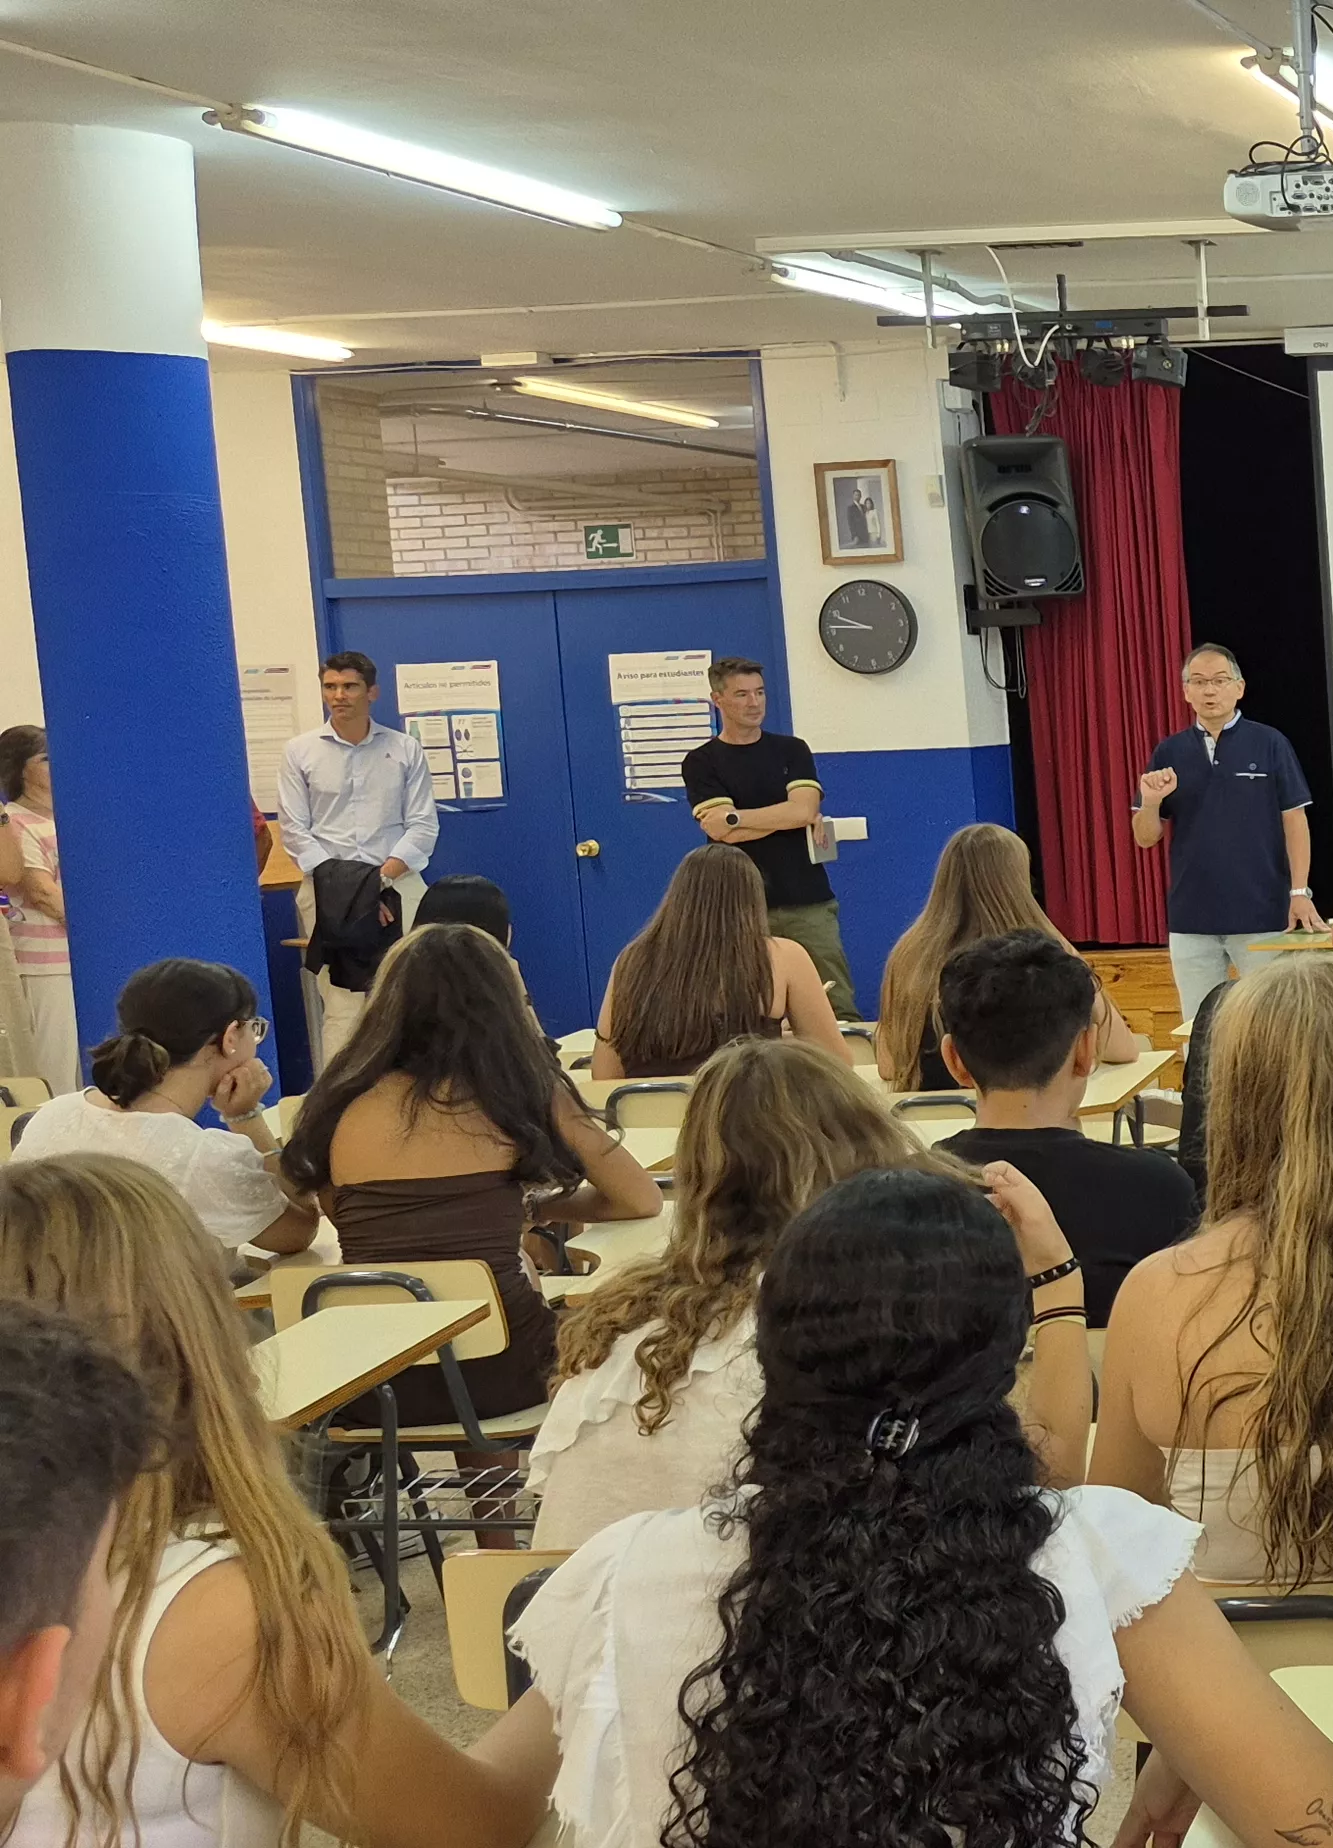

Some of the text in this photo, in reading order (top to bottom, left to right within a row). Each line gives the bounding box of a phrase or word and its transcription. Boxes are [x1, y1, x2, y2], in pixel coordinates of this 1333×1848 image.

[857, 588, 866, 596] 12
[841, 595, 850, 604] 11
[889, 602, 896, 611] 2
[898, 619, 904, 628] 3
[617, 669, 704, 680] Aviso para estudiantes
[449, 680, 491, 688] permitidos
